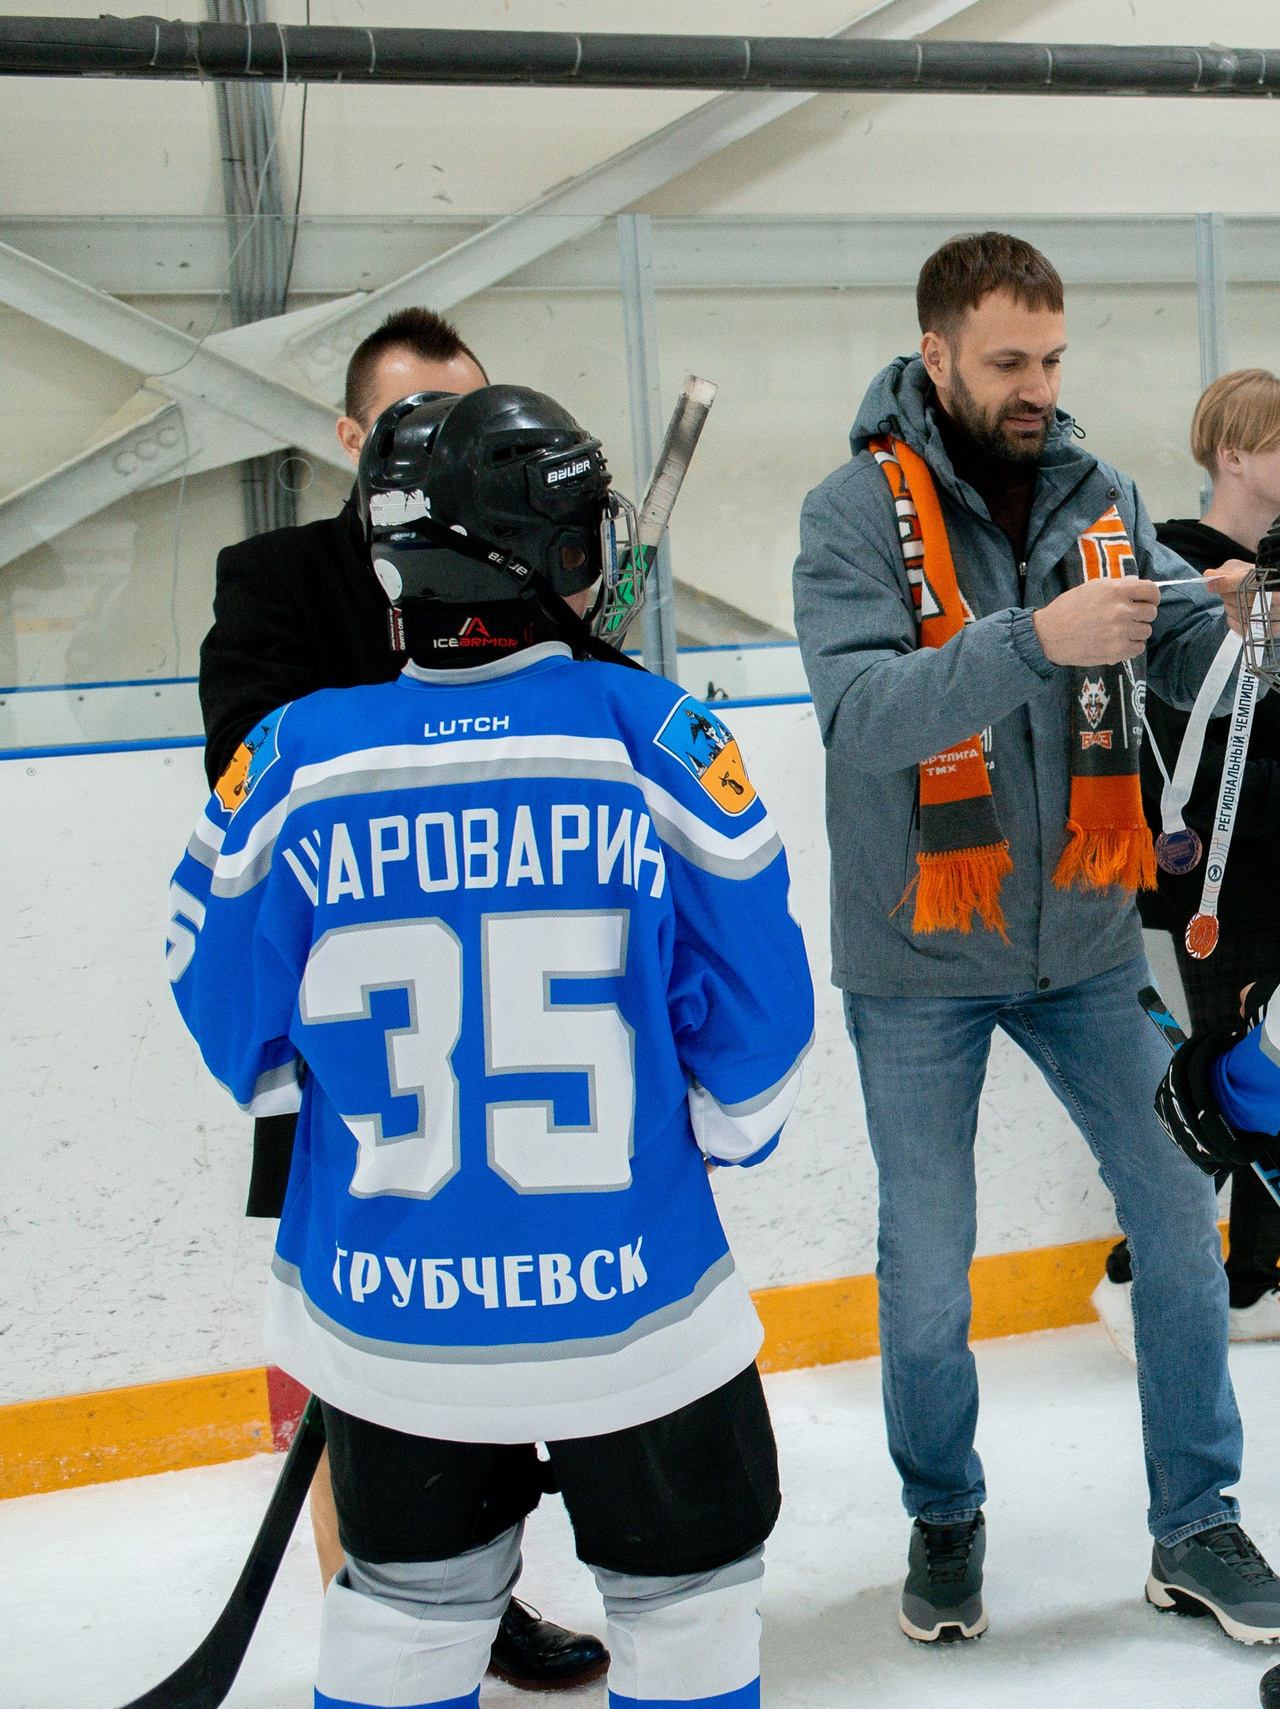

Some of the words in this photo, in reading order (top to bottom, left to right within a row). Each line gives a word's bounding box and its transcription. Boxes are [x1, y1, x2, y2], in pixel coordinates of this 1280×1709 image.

[547, 459, 591, 487] BAUER
[423, 715, 511, 738] LUTCH
[921, 748, 980, 766] ОРТЛИГА
[1217, 736, 1246, 833] РЕГИОНАЛЬНЫЙ
[300, 908, 636, 1201] 35
